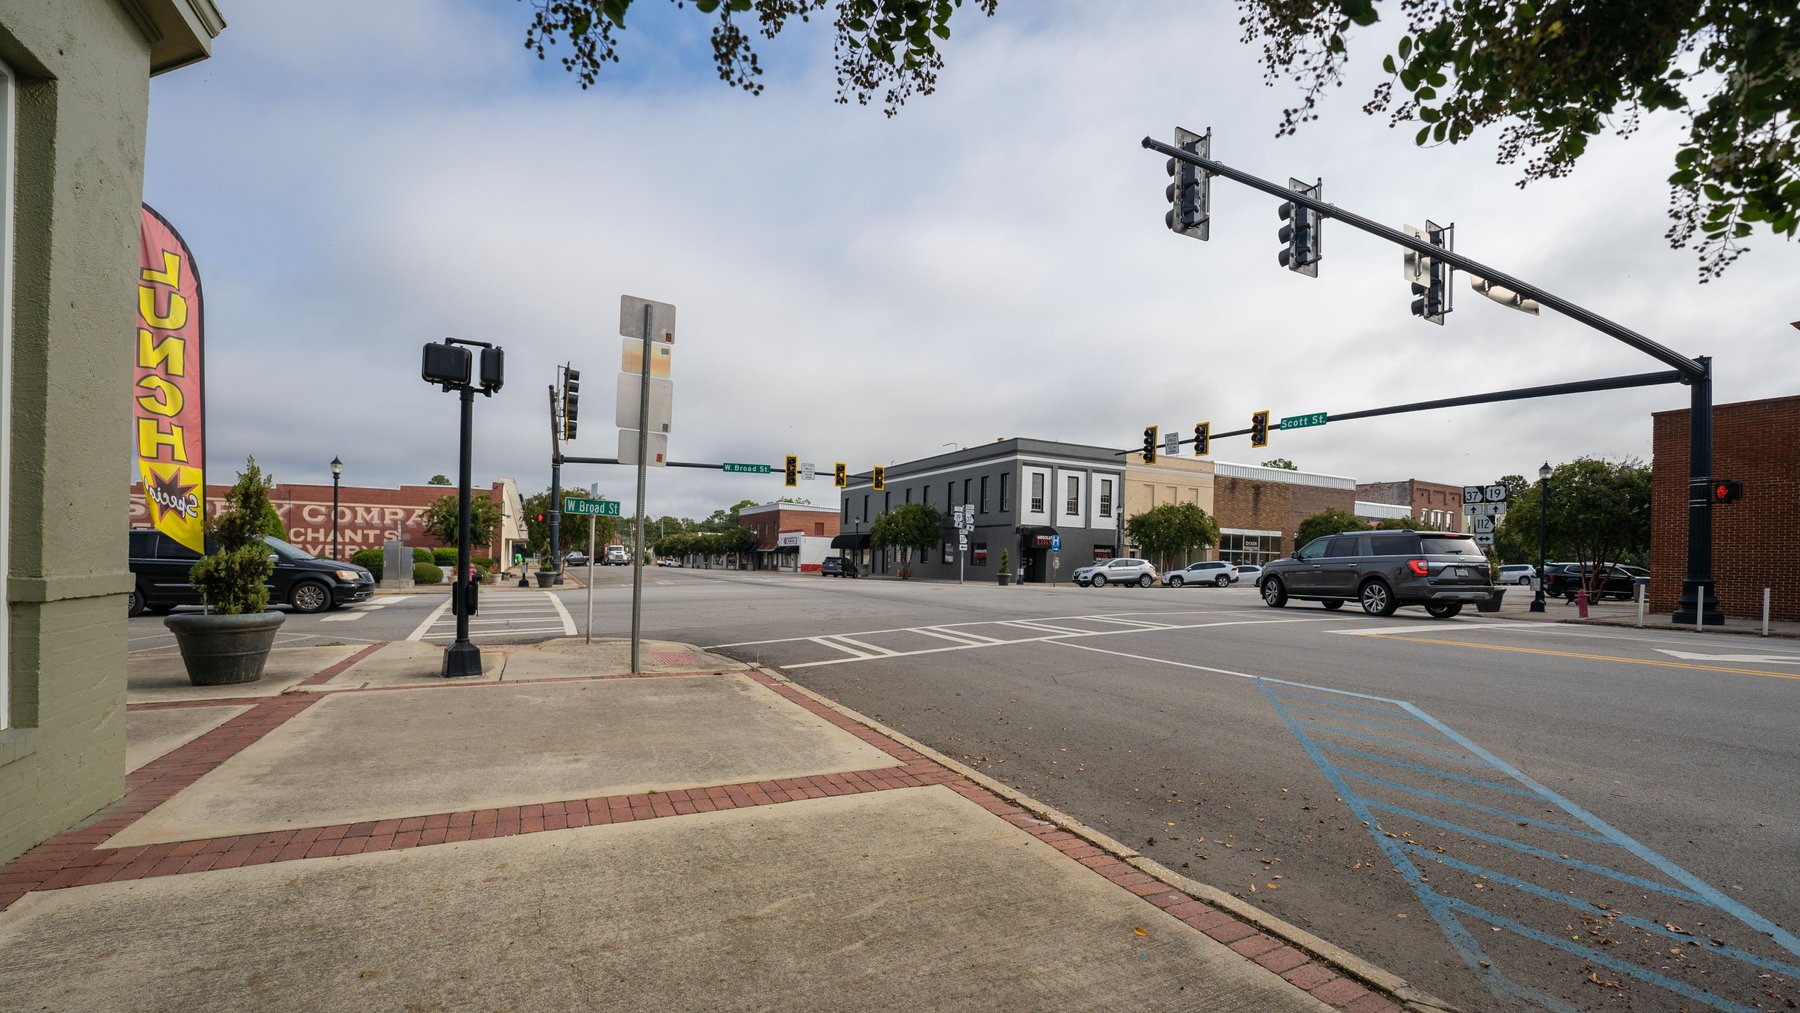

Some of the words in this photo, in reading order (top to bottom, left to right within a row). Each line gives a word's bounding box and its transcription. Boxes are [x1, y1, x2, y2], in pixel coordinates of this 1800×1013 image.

[1281, 417, 1308, 429] Scott
[1312, 415, 1326, 425] St.
[1466, 491, 1479, 501] 37
[1489, 488, 1501, 499] 19
[567, 499, 576, 512] W
[580, 500, 605, 514] Broad
[608, 502, 618, 515] St
[302, 504, 430, 526] COMPA
[1477, 518, 1490, 529] 112
